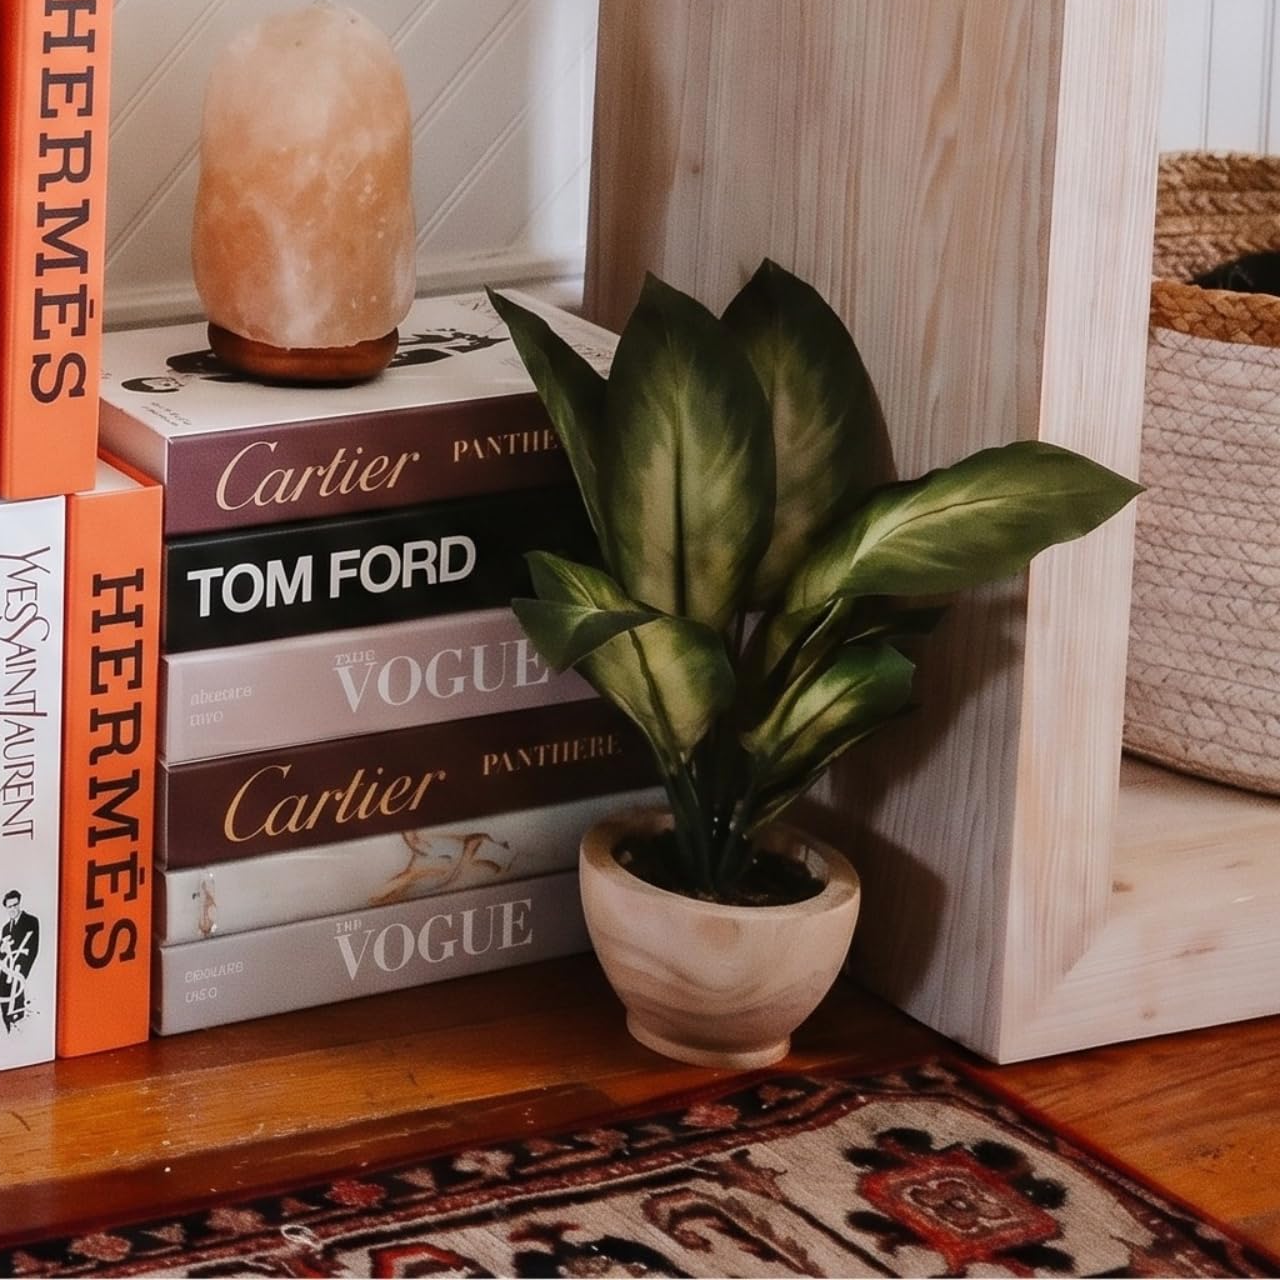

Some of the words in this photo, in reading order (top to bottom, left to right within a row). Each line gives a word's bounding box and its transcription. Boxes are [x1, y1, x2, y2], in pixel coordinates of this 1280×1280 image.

[215, 439, 420, 511] Cartier
[187, 555, 313, 617] TOM
[329, 535, 476, 599] FORD
[334, 637, 550, 713] VOGUE
[223, 764, 447, 843] Cartier
[334, 898, 534, 981] VOGUE
